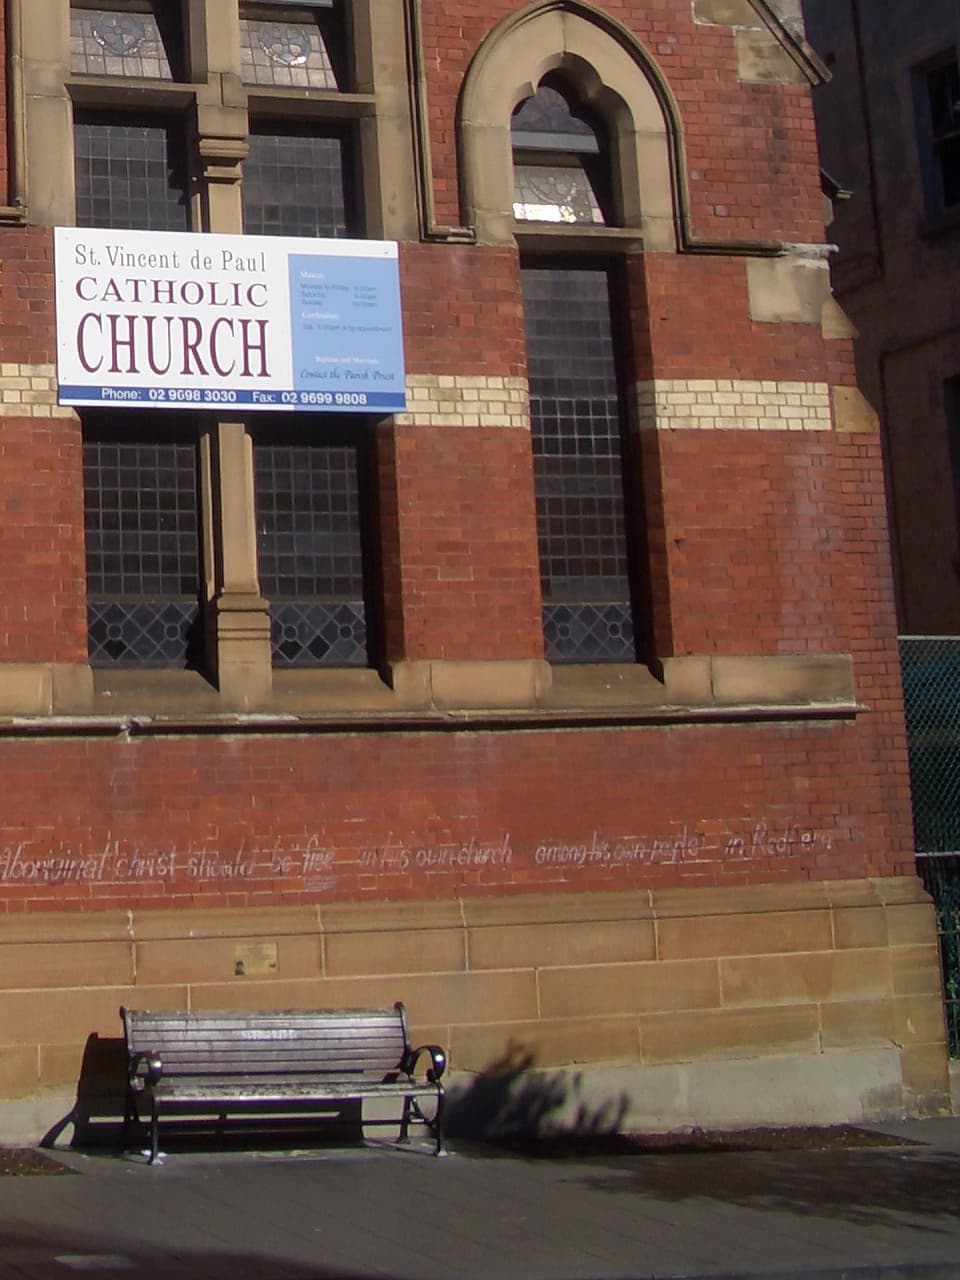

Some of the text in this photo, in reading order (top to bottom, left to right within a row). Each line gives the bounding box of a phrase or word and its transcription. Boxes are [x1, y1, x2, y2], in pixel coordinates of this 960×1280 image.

[75, 243, 266, 273] St. Vincent de Paul
[75, 276, 270, 308] CATHOLIC
[76, 311, 272, 378] CHURCH
[101, 387, 141, 400] Phone:
[148, 388, 167, 401] 02
[204, 390, 237, 403] 3030
[252, 391, 368, 406] Fax: 02 9699 9808
[535, 844, 588, 866] among
